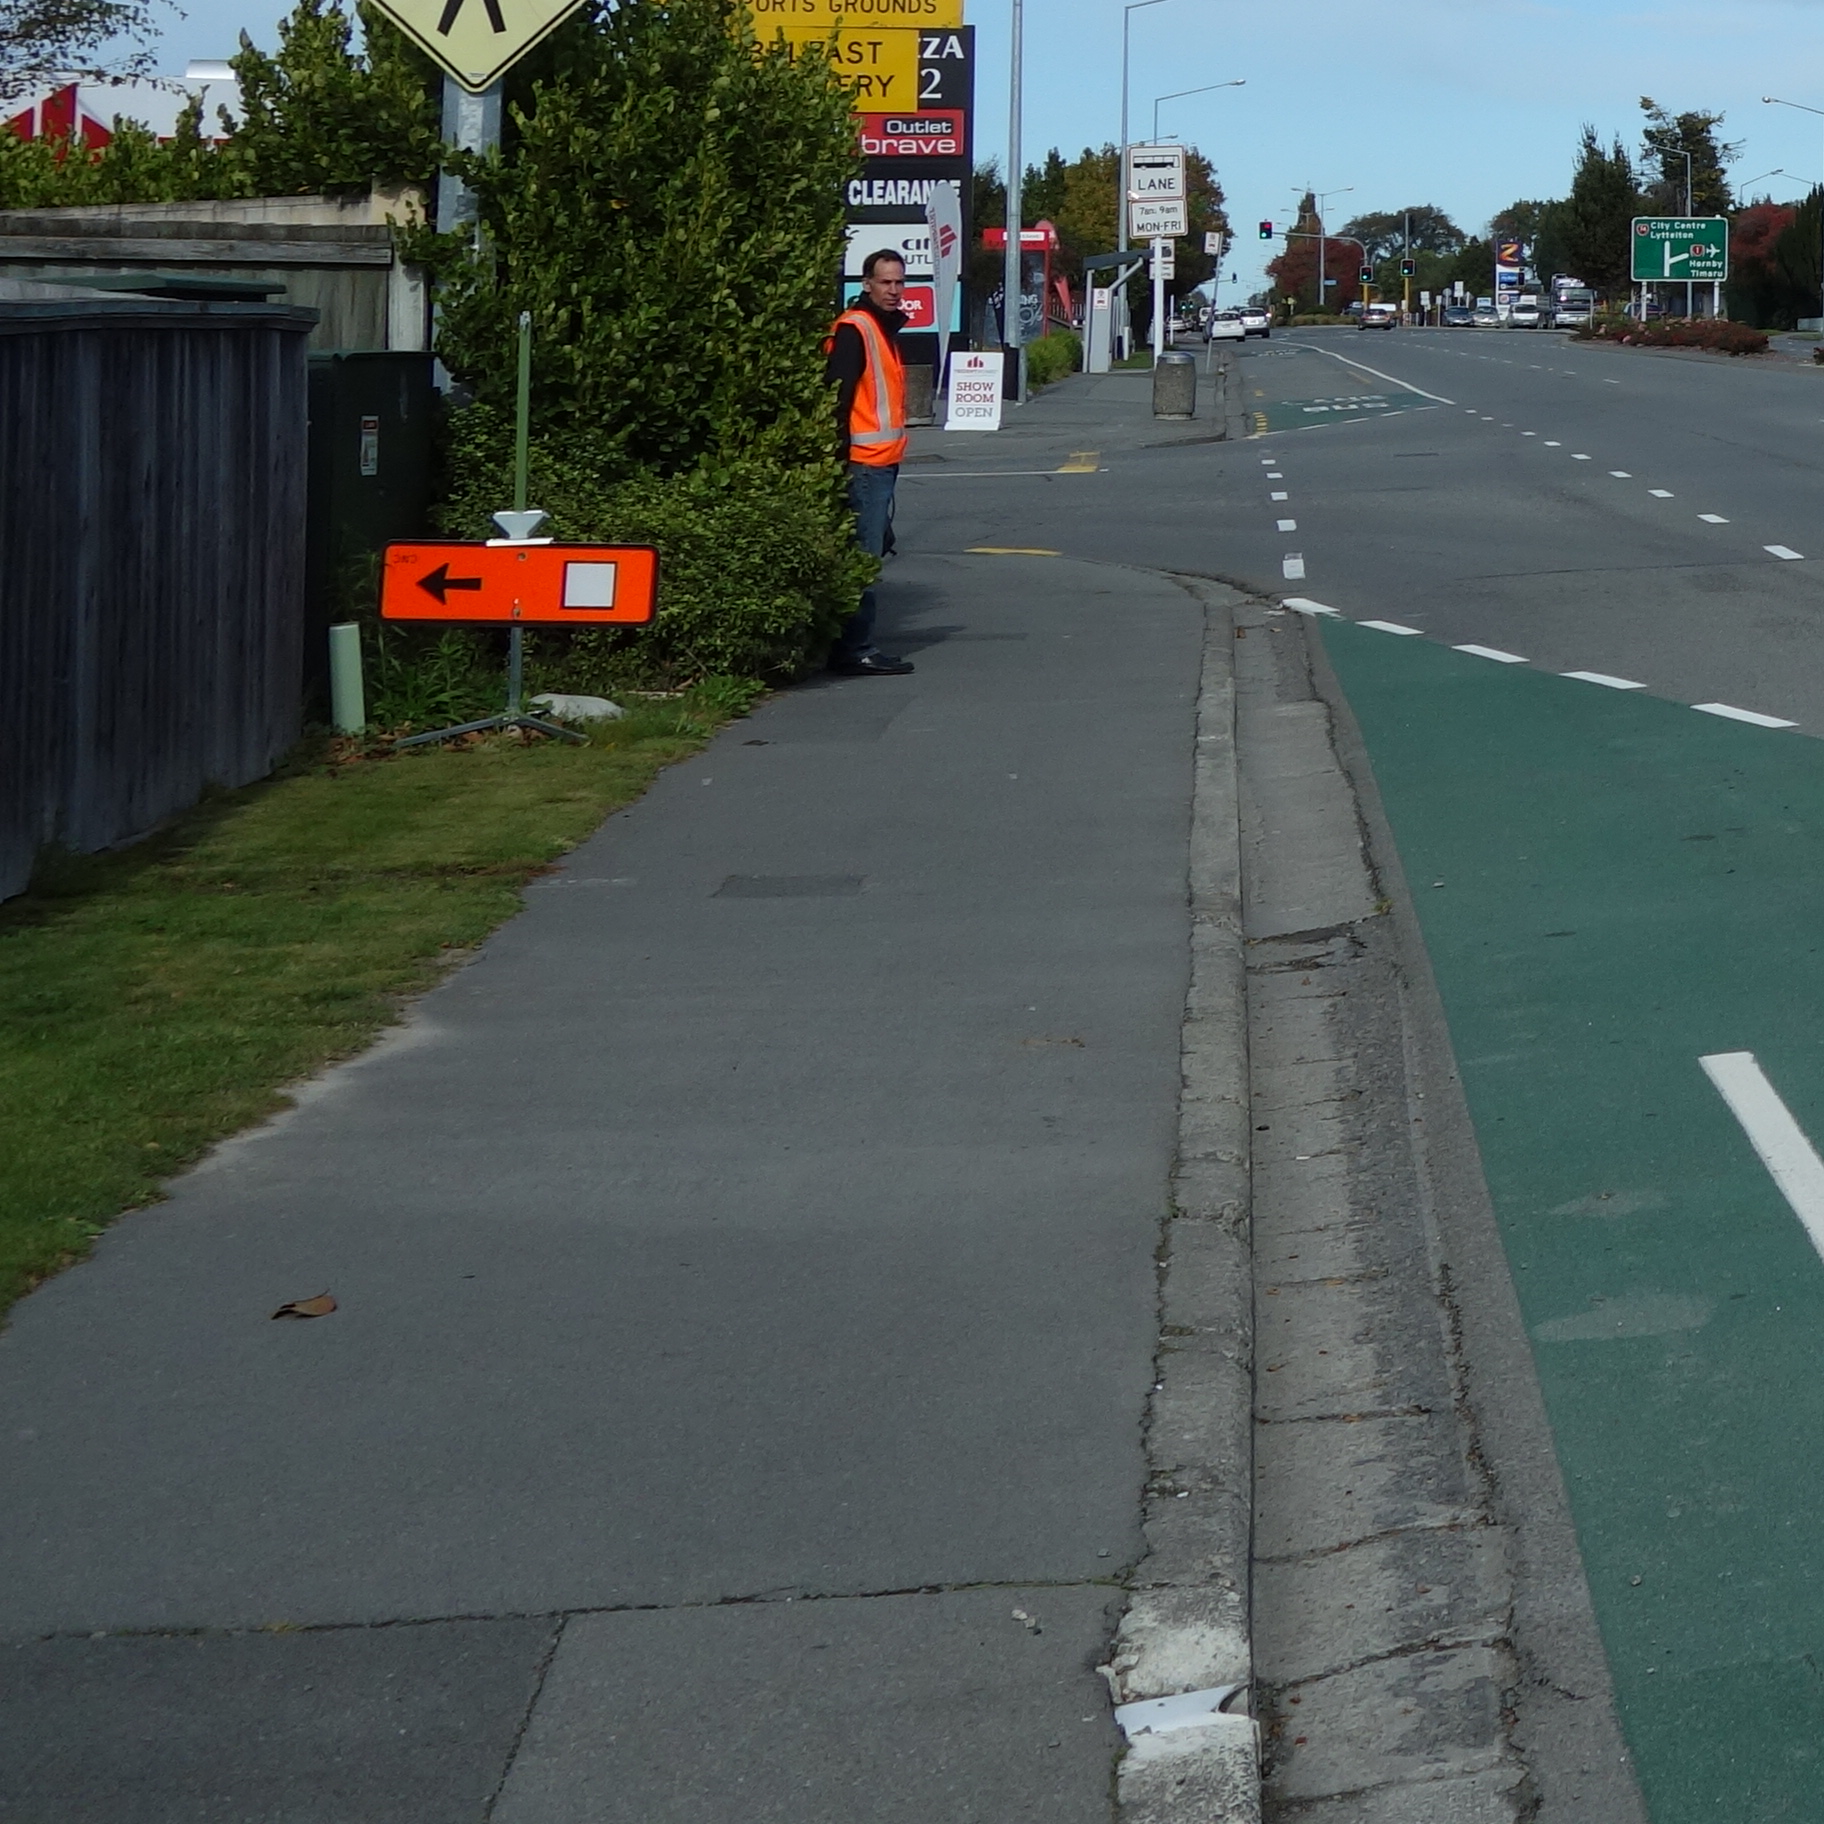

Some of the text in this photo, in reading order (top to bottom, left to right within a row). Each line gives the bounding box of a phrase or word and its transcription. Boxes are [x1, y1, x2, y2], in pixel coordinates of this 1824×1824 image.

[886, 119, 952, 134] Outlet
[861, 133, 957, 155] brave
[1137, 177, 1176, 191] LANE
[1650, 221, 1671, 231] City
[1674, 221, 1707, 230] Centre
[1650, 231, 1695, 240] Lyttelton
[1689, 259, 1724, 269] Hornby
[1690, 269, 1724, 278] Timaru
[956, 381, 995, 392] SHOW
[955, 393, 995, 403] ROOM
[955, 406, 994, 418] OPEN
